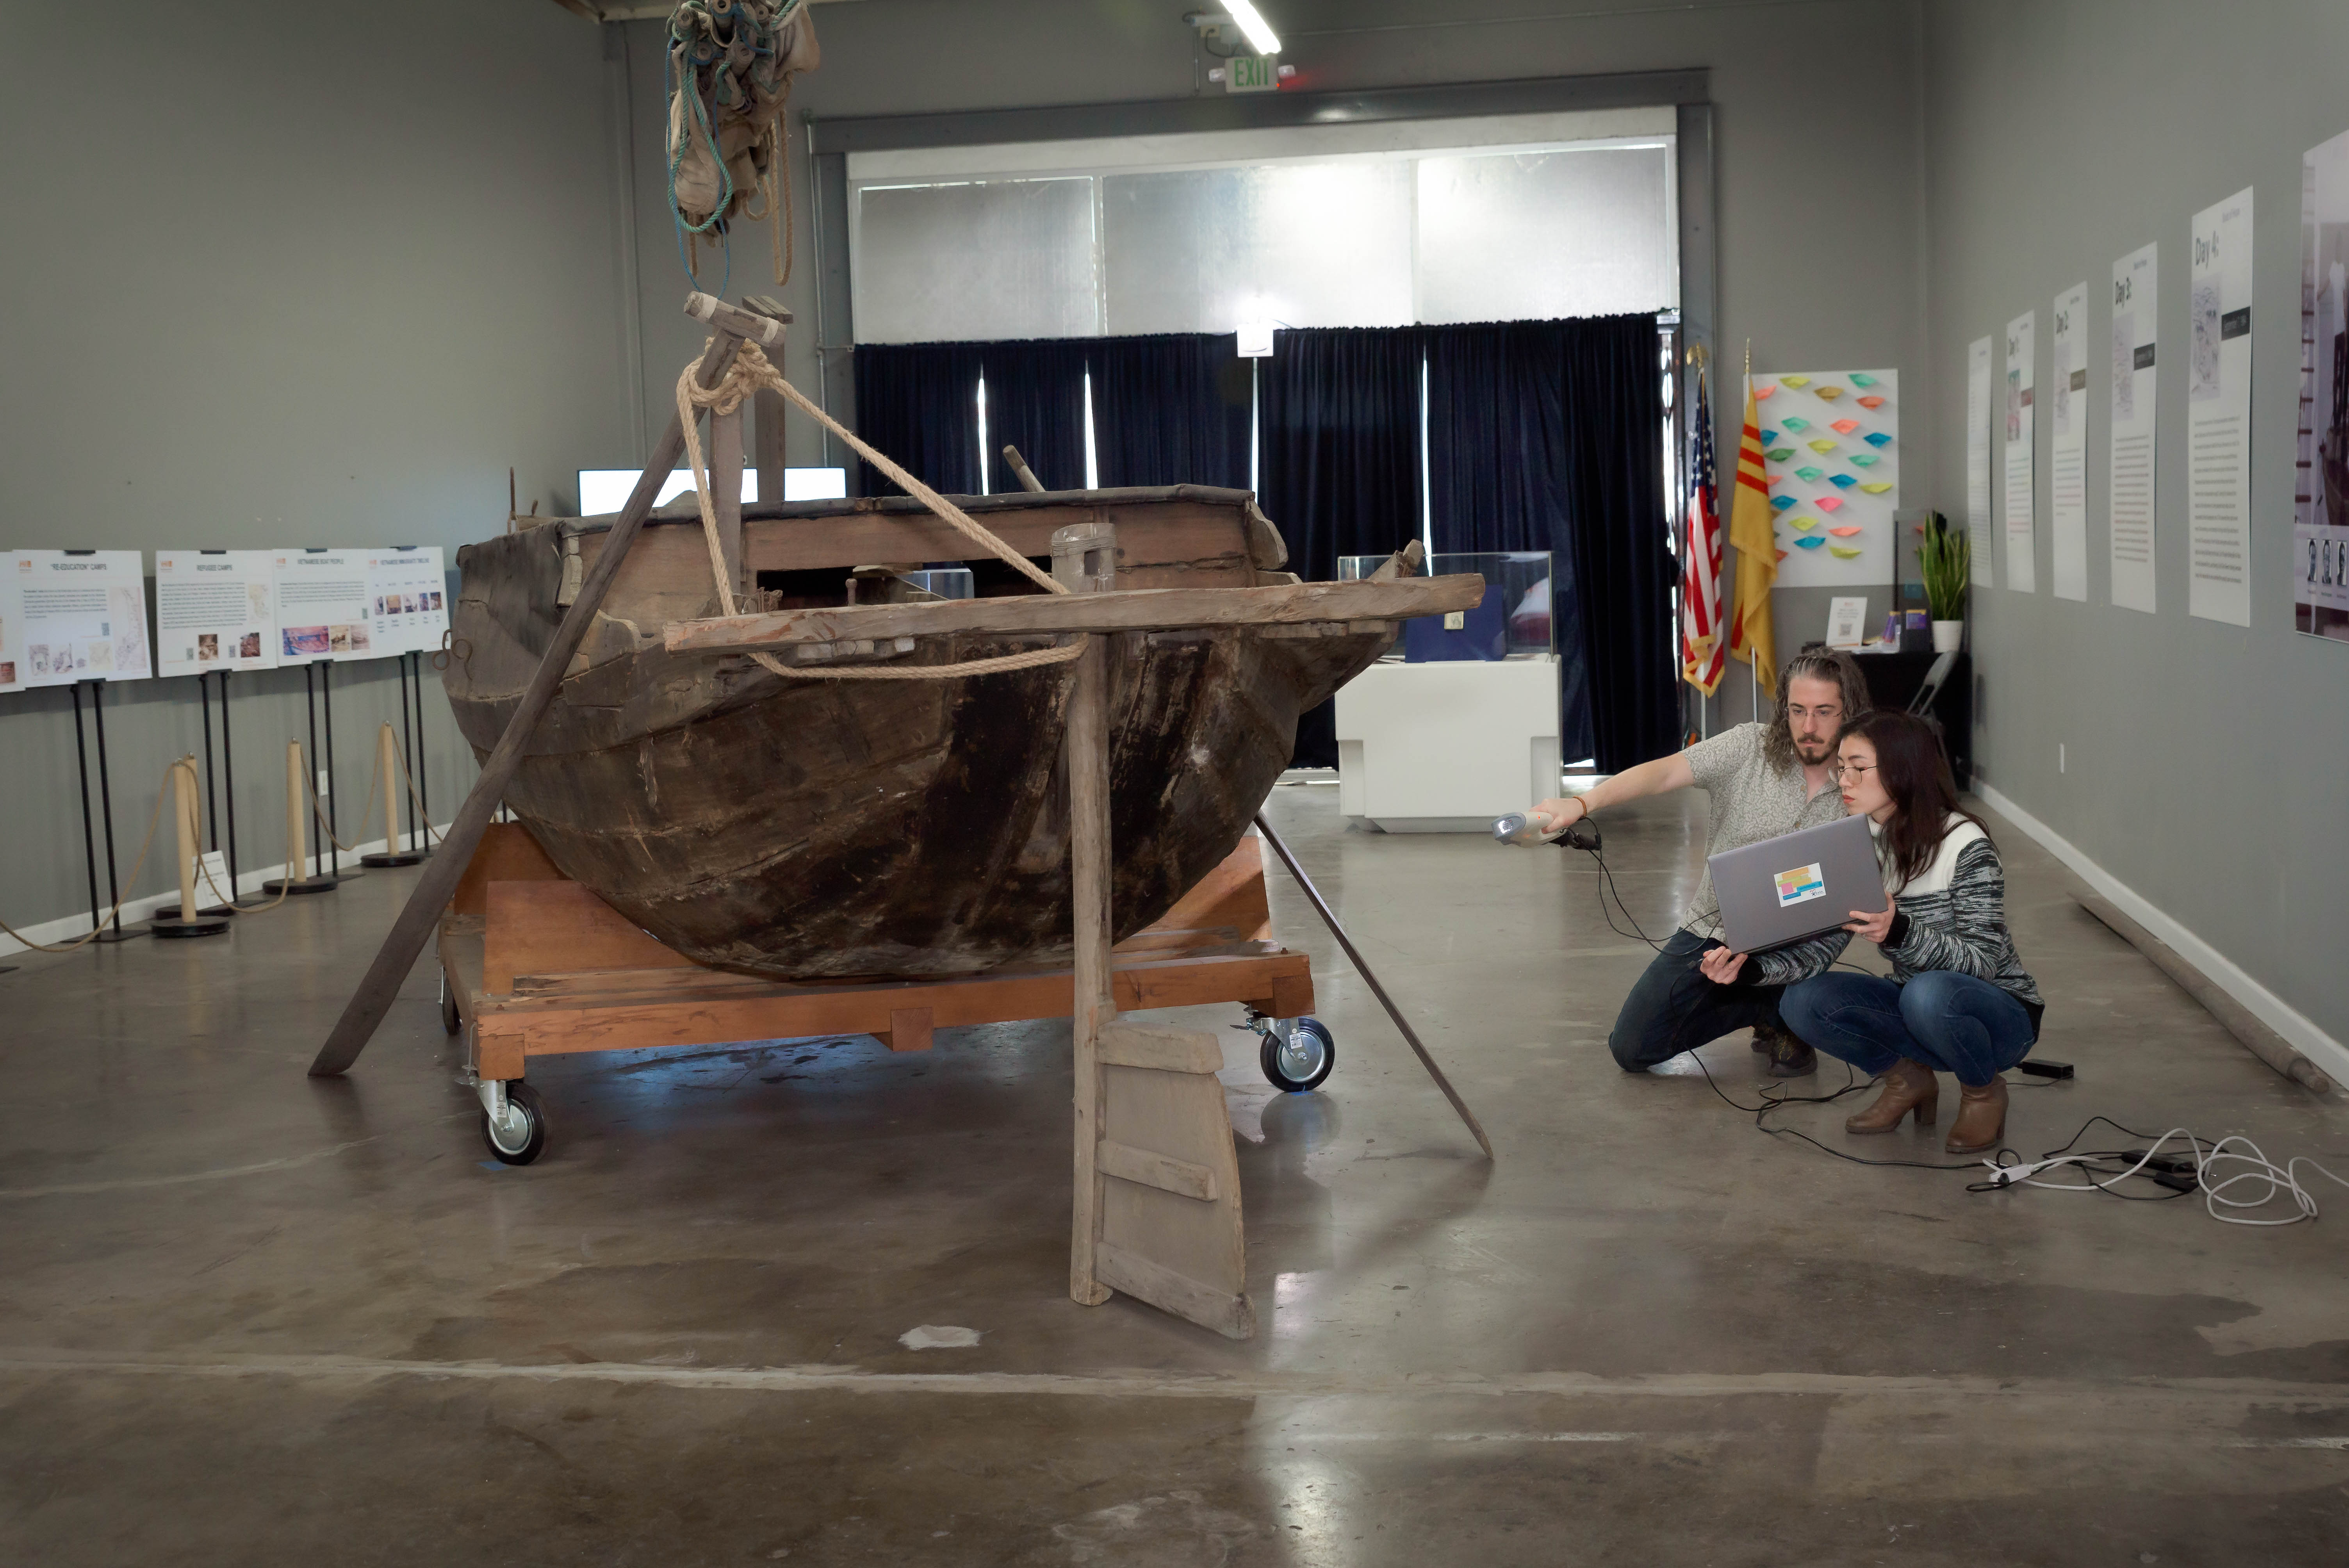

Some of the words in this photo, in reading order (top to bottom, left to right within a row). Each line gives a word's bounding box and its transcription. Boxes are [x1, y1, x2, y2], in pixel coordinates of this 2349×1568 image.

[1235, 59, 1269, 86] EXIT
[2196, 237, 2210, 270] Day
[2212, 230, 2219, 258] 4:
[2115, 280, 2125, 309] Day
[2126, 276, 2132, 300] 3:
[2056, 312, 2064, 337] Day
